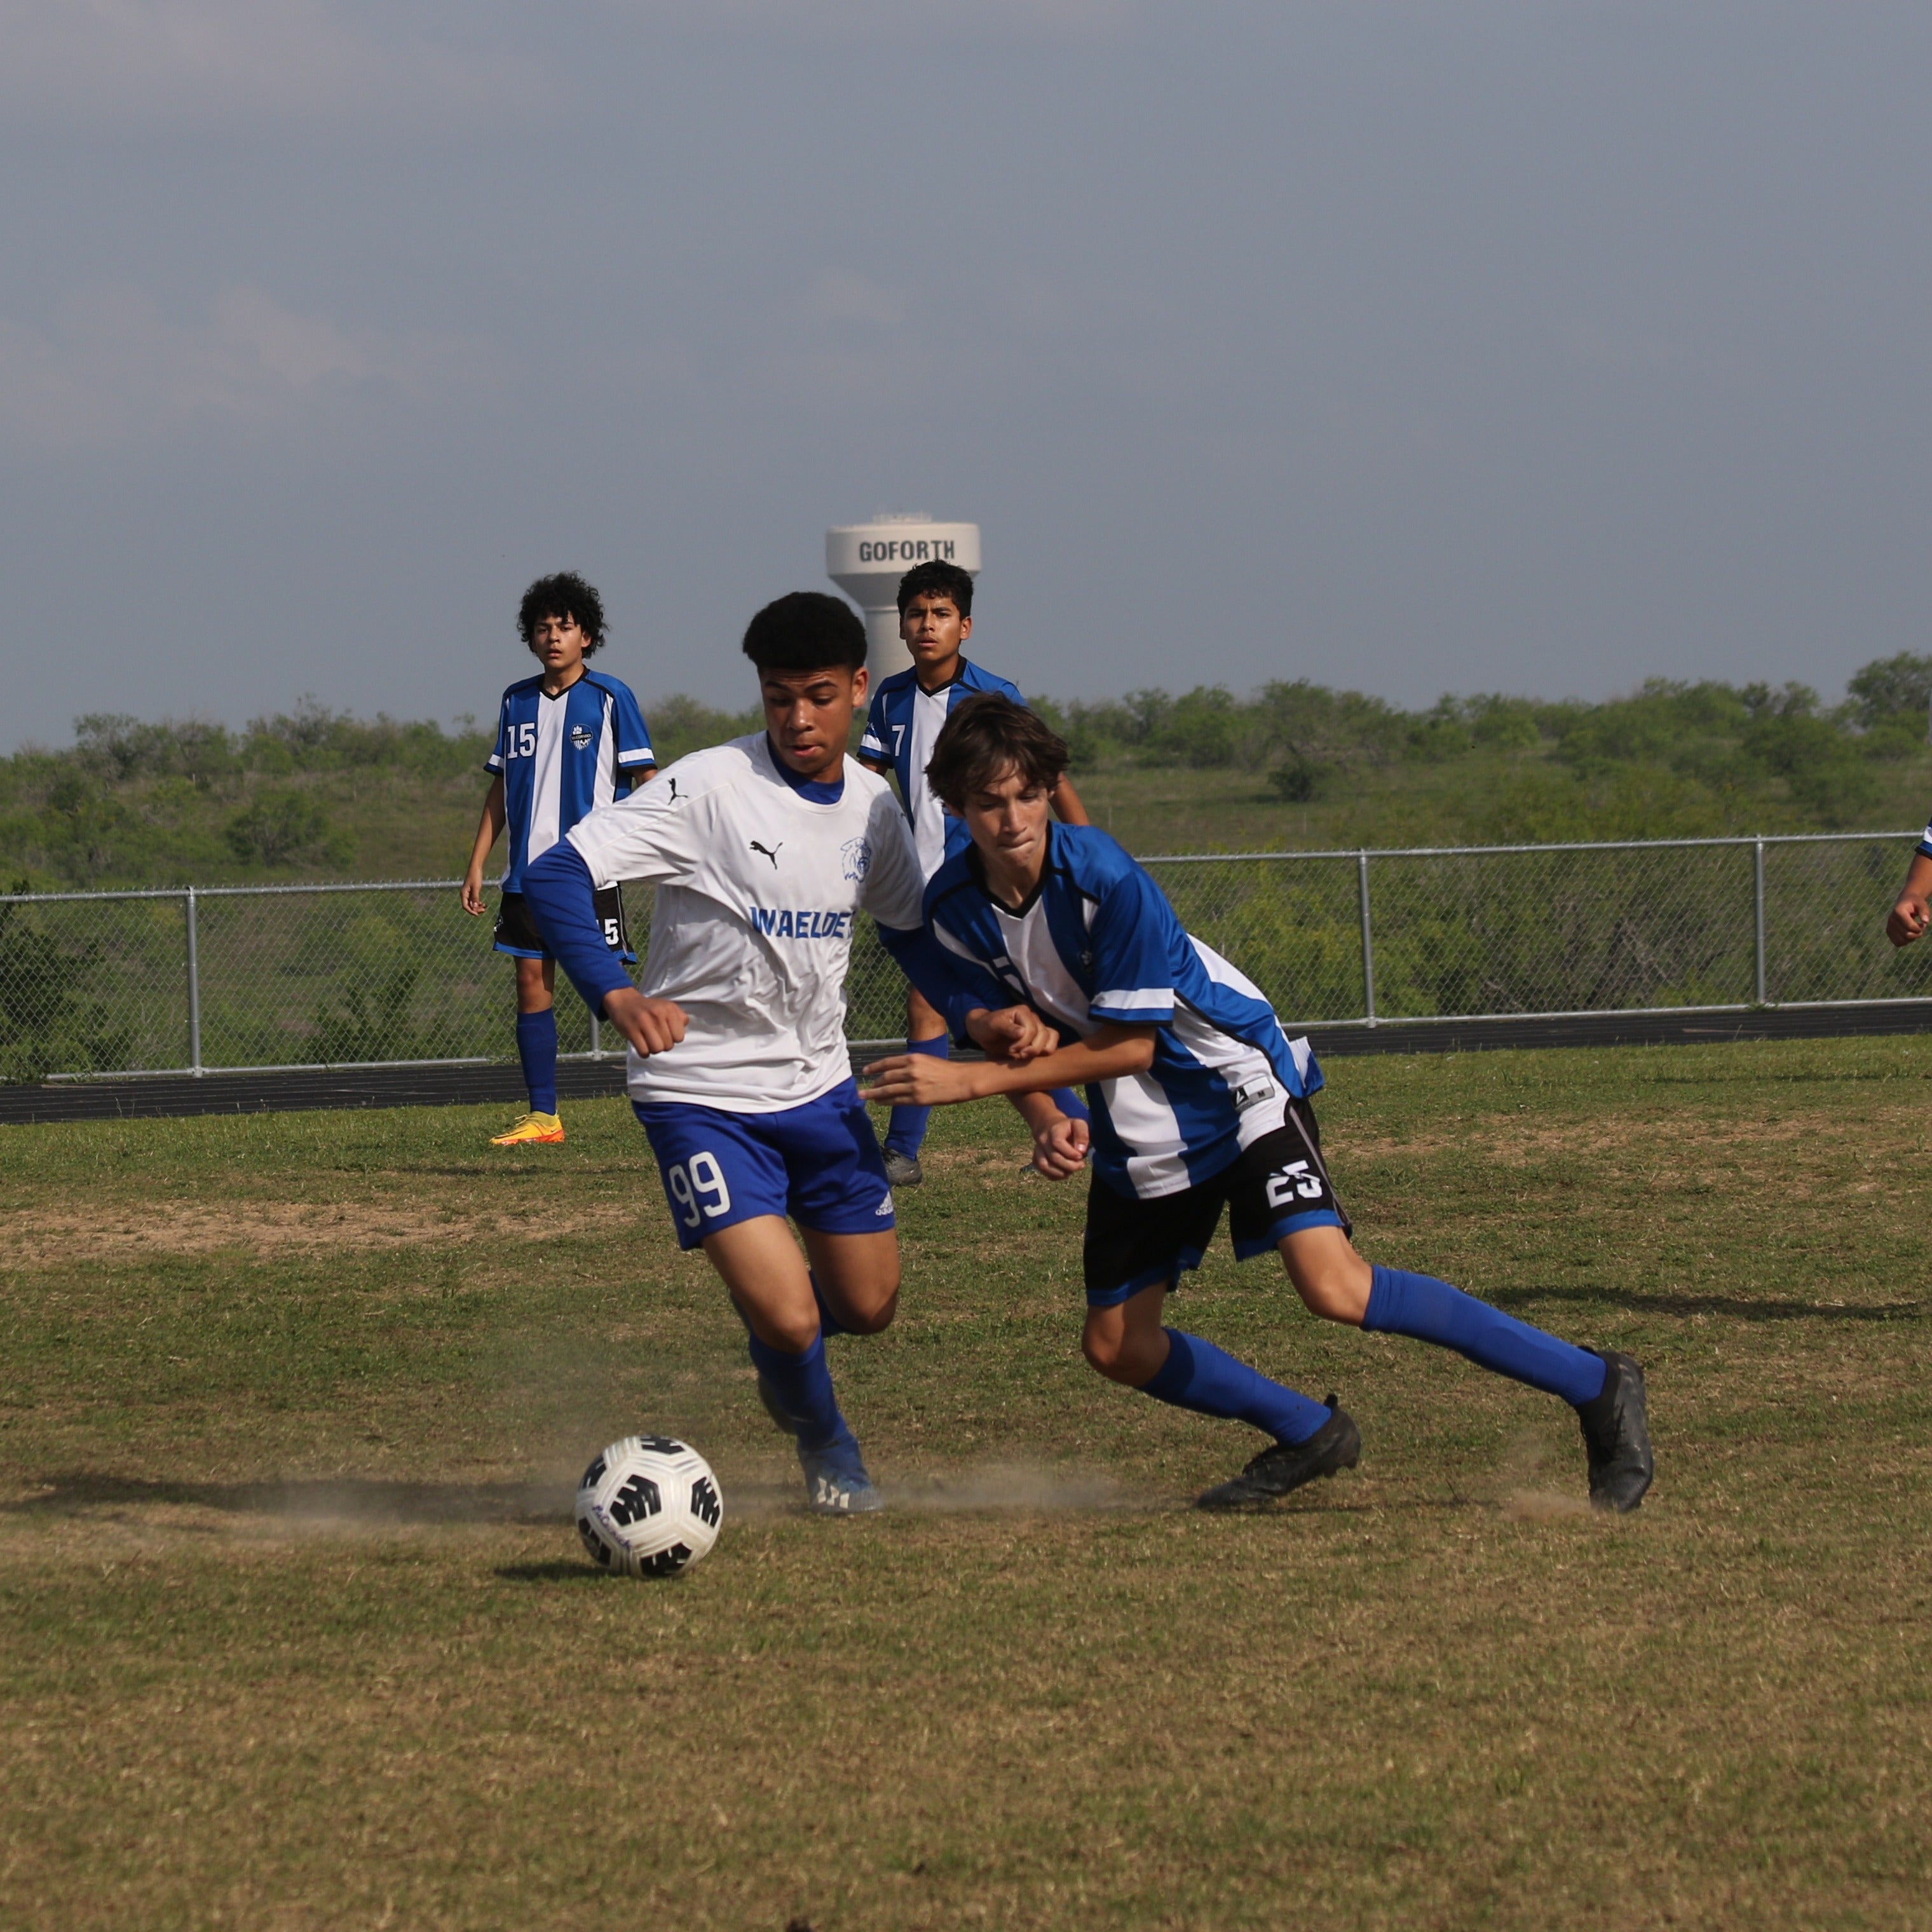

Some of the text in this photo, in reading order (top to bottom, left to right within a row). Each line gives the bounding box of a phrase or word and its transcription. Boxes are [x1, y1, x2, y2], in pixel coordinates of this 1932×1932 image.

[859, 540, 955, 562] GOFORTH
[507, 722, 536, 759] 15
[892, 724, 906, 757] 7
[595, 918, 619, 946] 5
[749, 906, 855, 939] WAELDE
[669, 1151, 731, 1228] 99
[1266, 1160, 1323, 1208] 25
